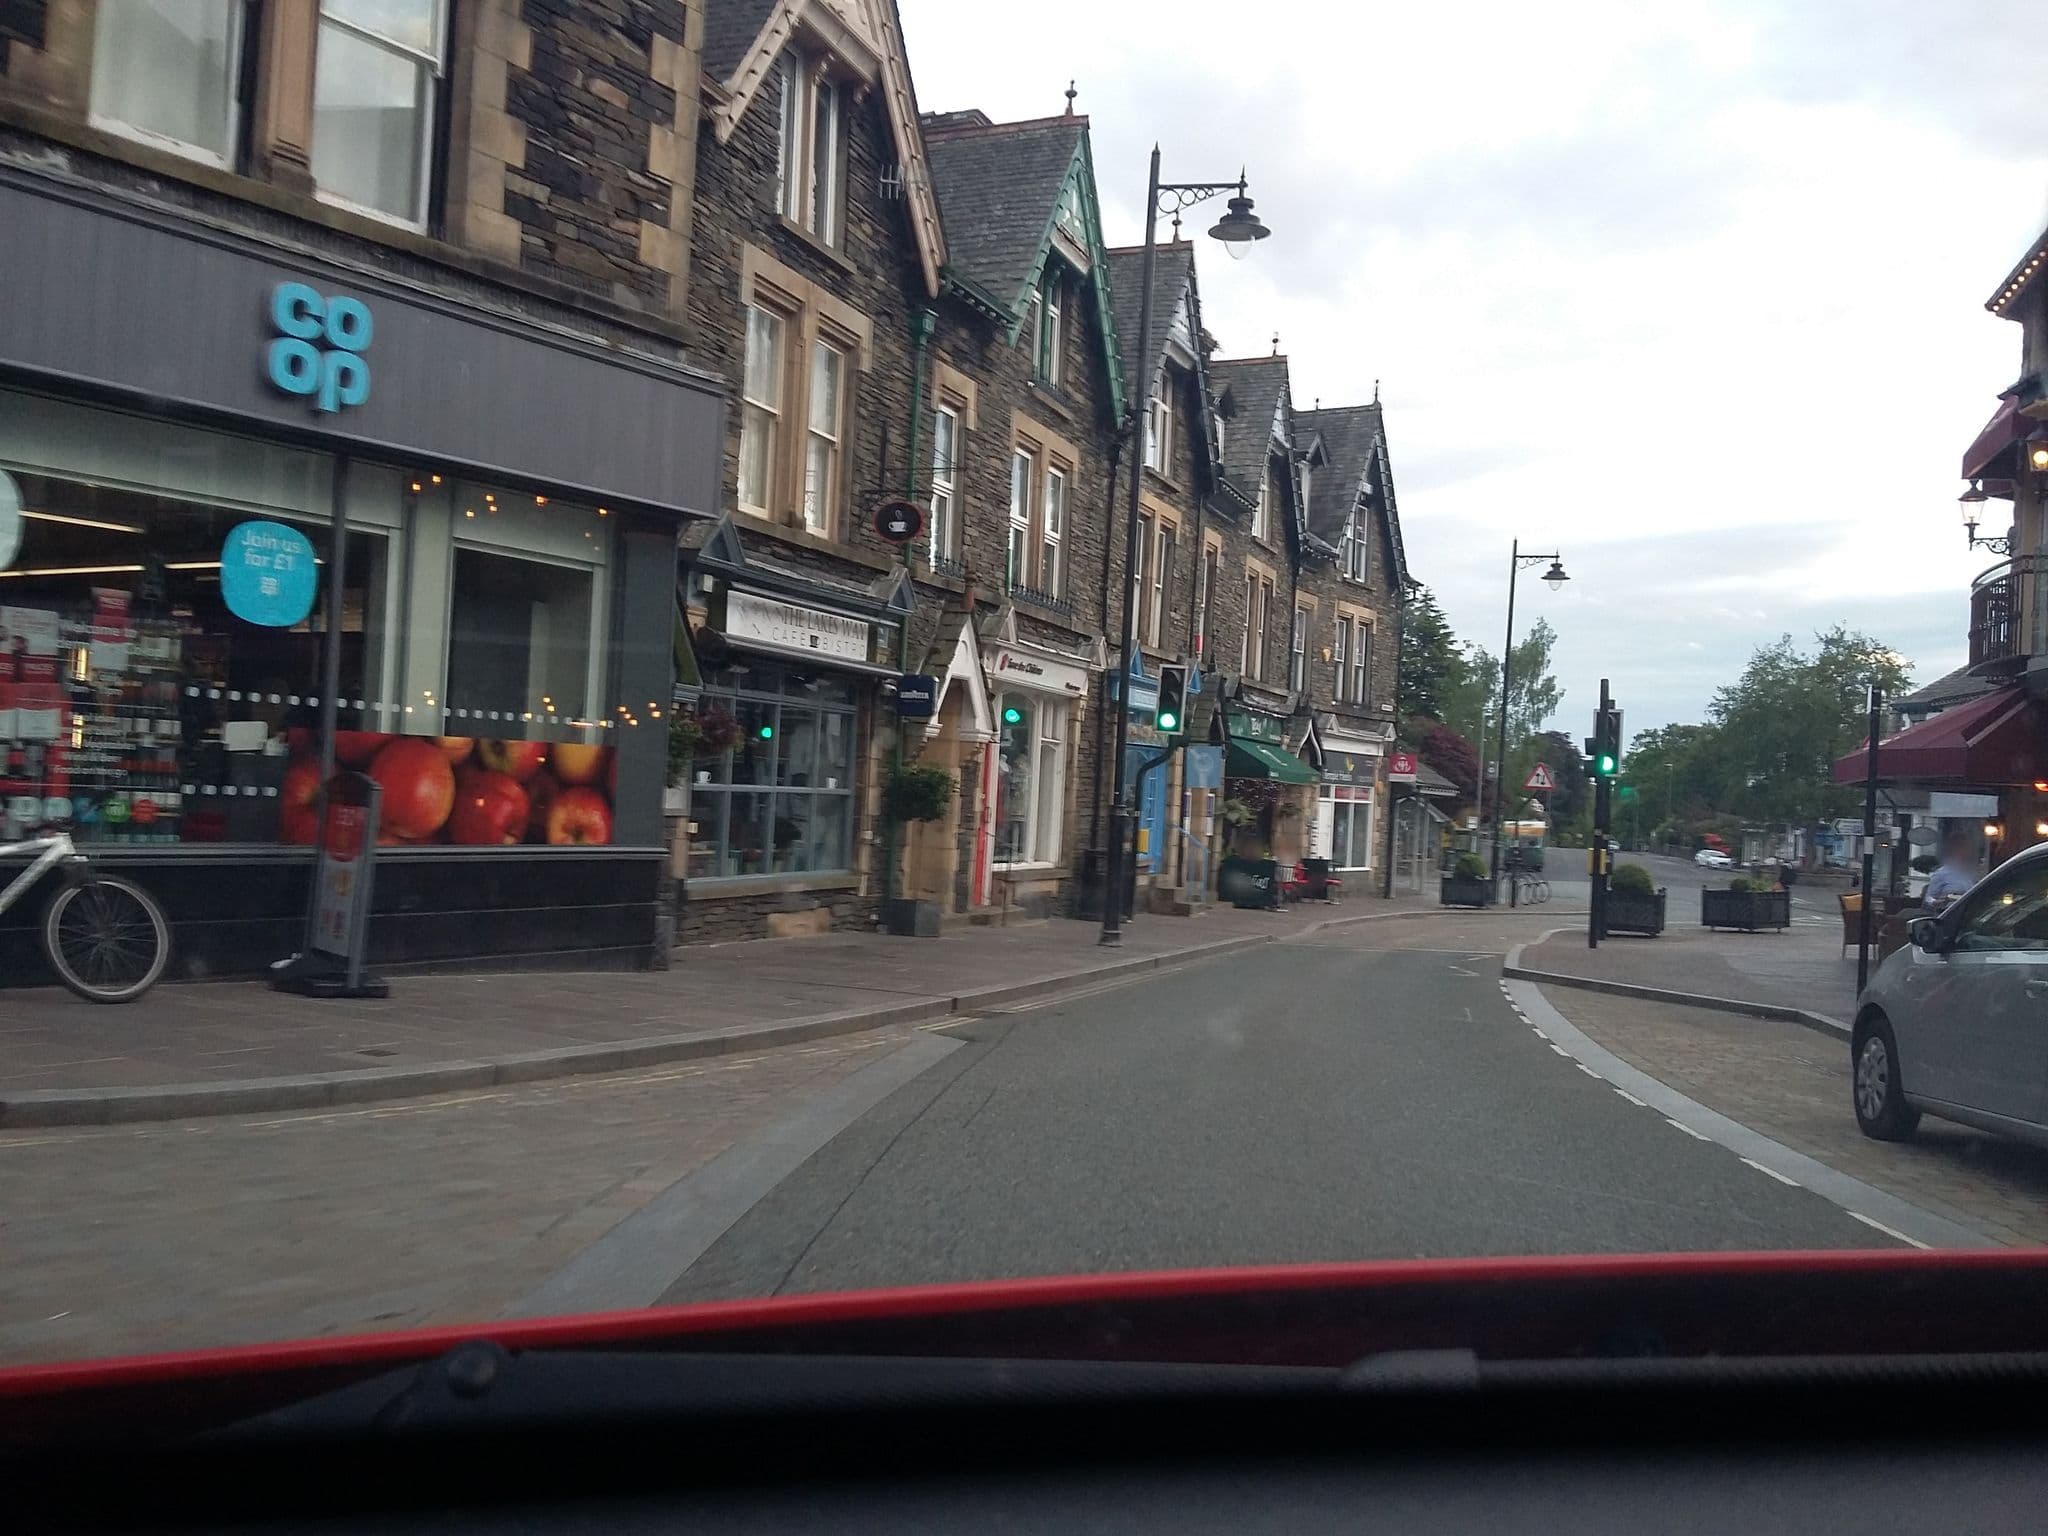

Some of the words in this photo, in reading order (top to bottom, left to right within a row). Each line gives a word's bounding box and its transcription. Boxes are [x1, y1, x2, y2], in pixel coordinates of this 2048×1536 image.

[241, 529, 277, 550] Join
[281, 540, 302, 554] us
[244, 548, 271, 567] for
